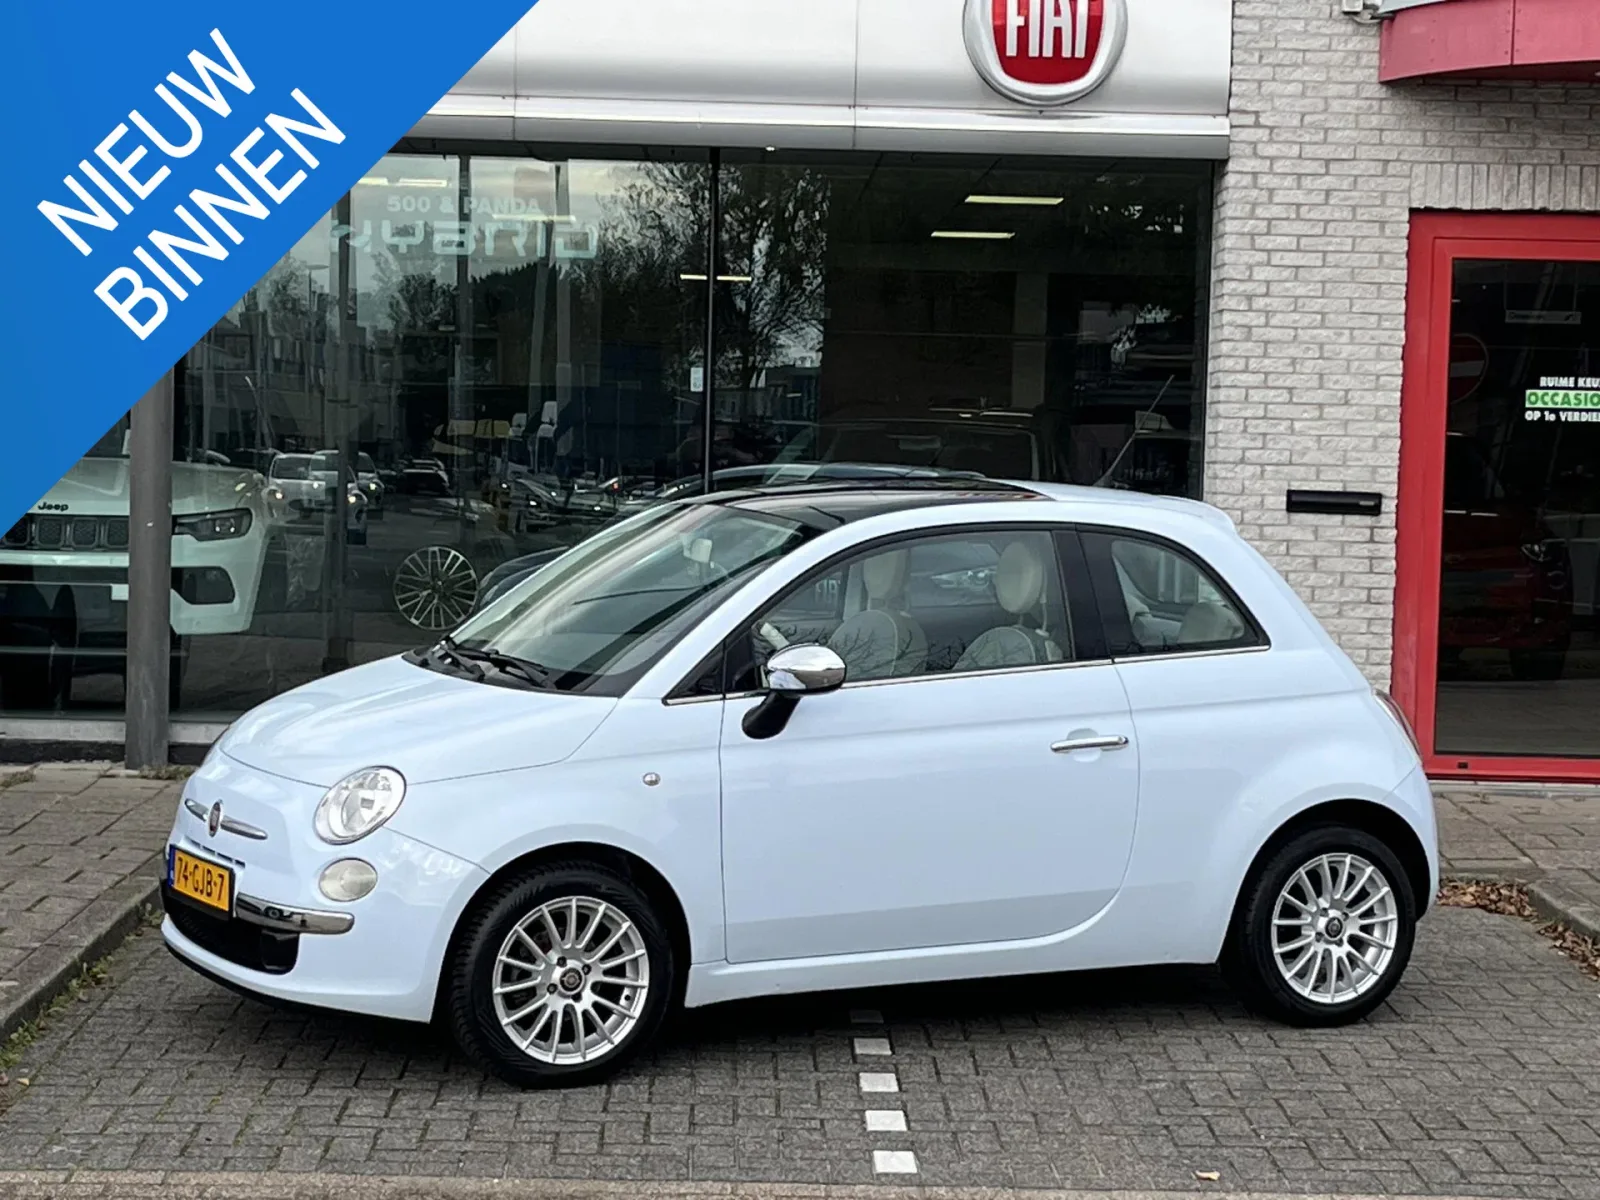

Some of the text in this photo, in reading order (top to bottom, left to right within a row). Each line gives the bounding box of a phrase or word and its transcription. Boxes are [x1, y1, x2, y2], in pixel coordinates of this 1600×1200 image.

[1005, 0, 1088, 58] FIAT
[386, 196, 541, 215] 500 & PANDA
[1540, 376, 1600, 388] RUIME KEU
[1527, 391, 1600, 406] OCCASIO
[1525, 410, 1541, 421] OP
[38, 501, 69, 512] Jeep
